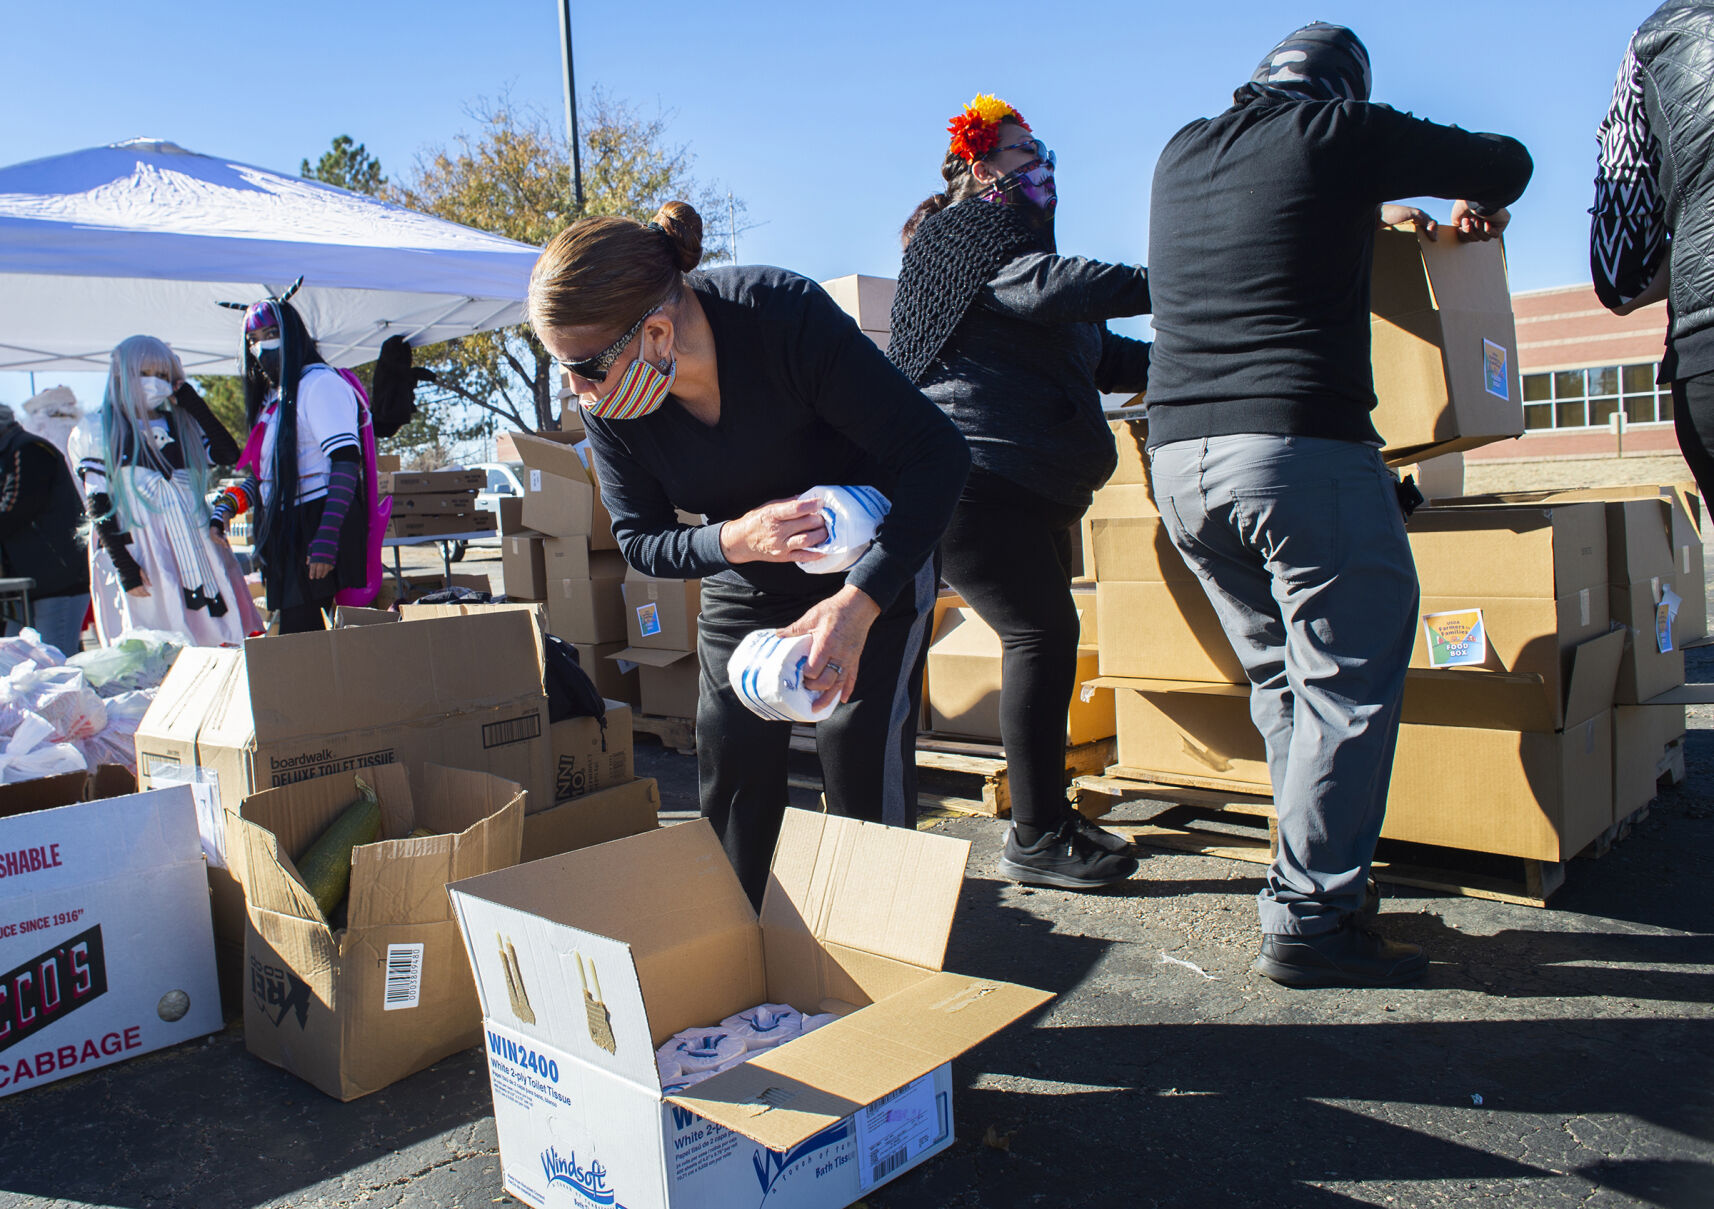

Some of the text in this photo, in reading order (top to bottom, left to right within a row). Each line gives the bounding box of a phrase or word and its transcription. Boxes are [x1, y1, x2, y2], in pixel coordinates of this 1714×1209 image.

[270, 749, 333, 769] boardwalk
[357, 751, 395, 770] TISSUE
[19, 916, 50, 935] SINCE
[488, 1030, 559, 1083] WIN2400
[491, 1057, 509, 1075] White
[511, 1067, 527, 1085] 2-ply
[527, 1076, 546, 1094] Toilet
[547, 1085, 571, 1106] Tissue
[674, 1130, 703, 1150] White
[541, 1145, 606, 1197] Windsoft
[816, 1161, 833, 1179] Bath
